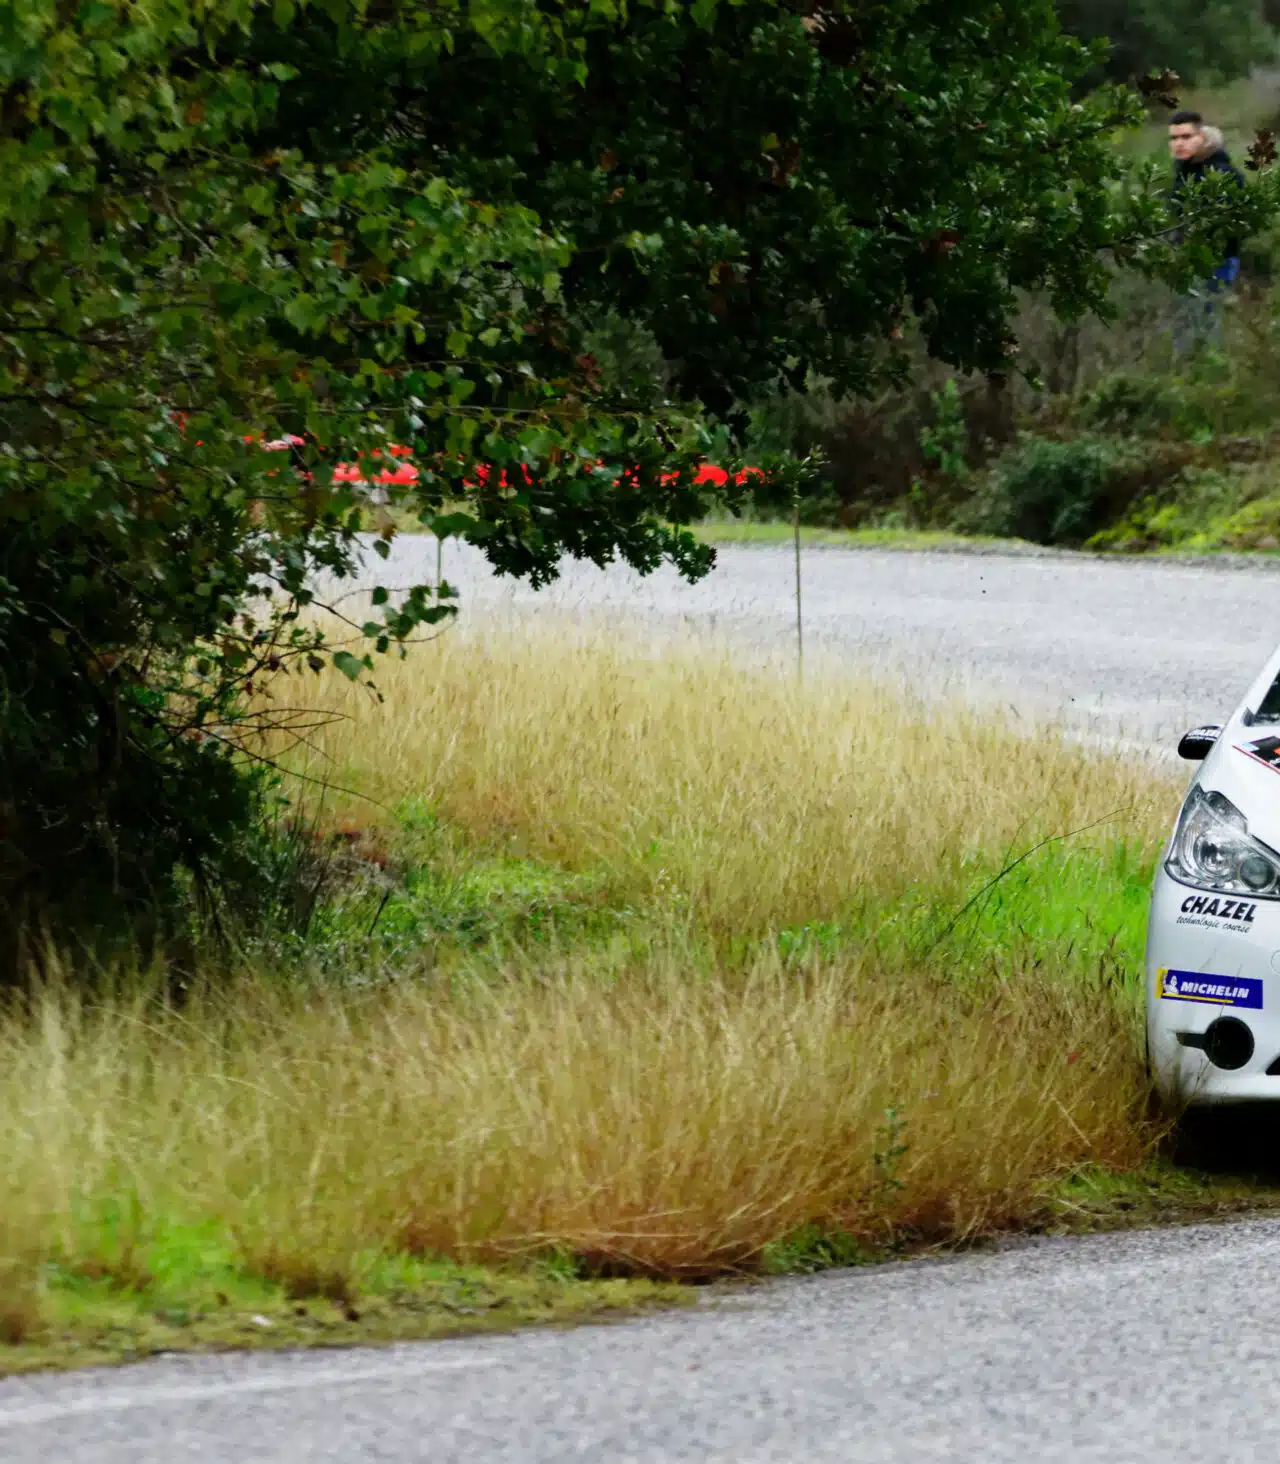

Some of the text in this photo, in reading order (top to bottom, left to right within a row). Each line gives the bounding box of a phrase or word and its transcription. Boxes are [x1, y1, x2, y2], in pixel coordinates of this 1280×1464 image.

[1181, 896, 1257, 922] CHAZEL
[1177, 915, 1251, 934] technologie course
[1180, 981, 1249, 998] MICHELIN
